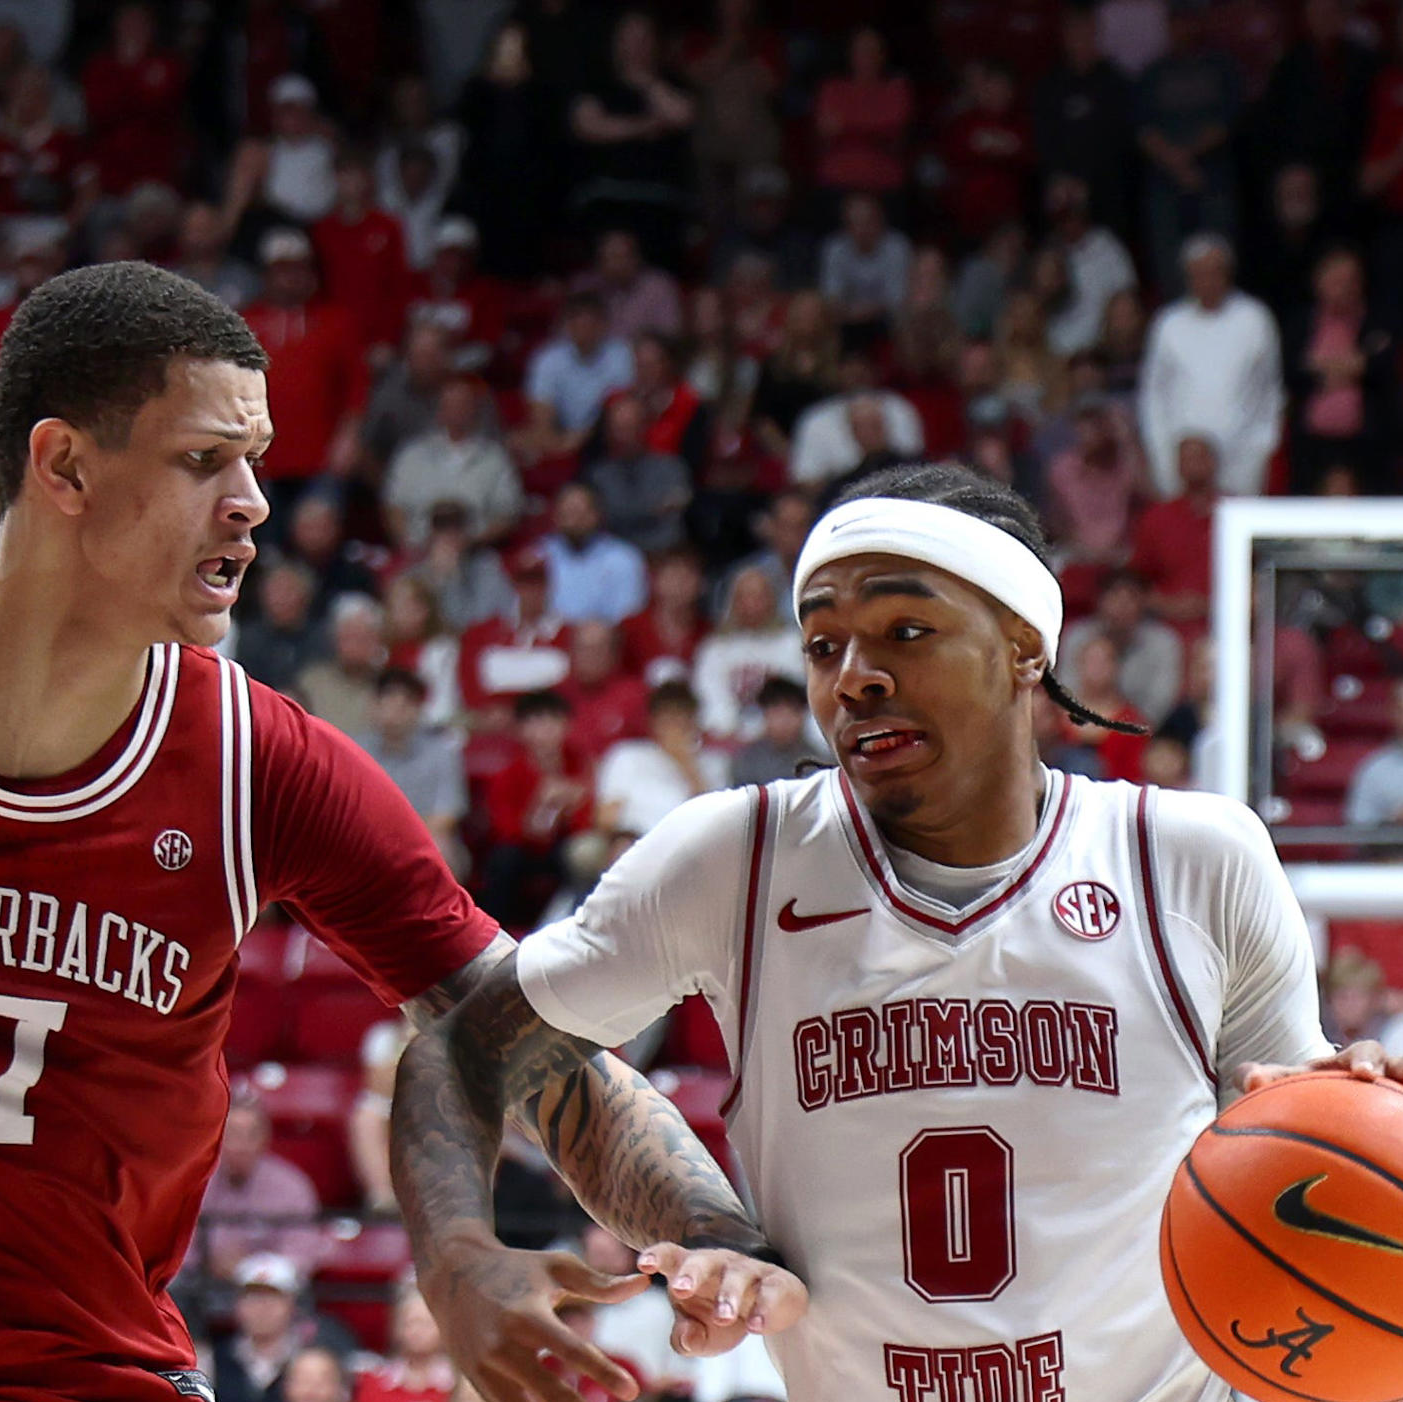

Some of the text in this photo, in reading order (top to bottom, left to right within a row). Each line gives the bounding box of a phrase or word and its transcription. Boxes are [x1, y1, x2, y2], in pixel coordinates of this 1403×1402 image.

[157, 832, 190, 868] SEC
[1058, 884, 1117, 935] SEC
[793, 998, 1121, 1113] CRIMSON
[899, 1125, 1018, 1304] 0
[1230, 1306, 1335, 1378] A
